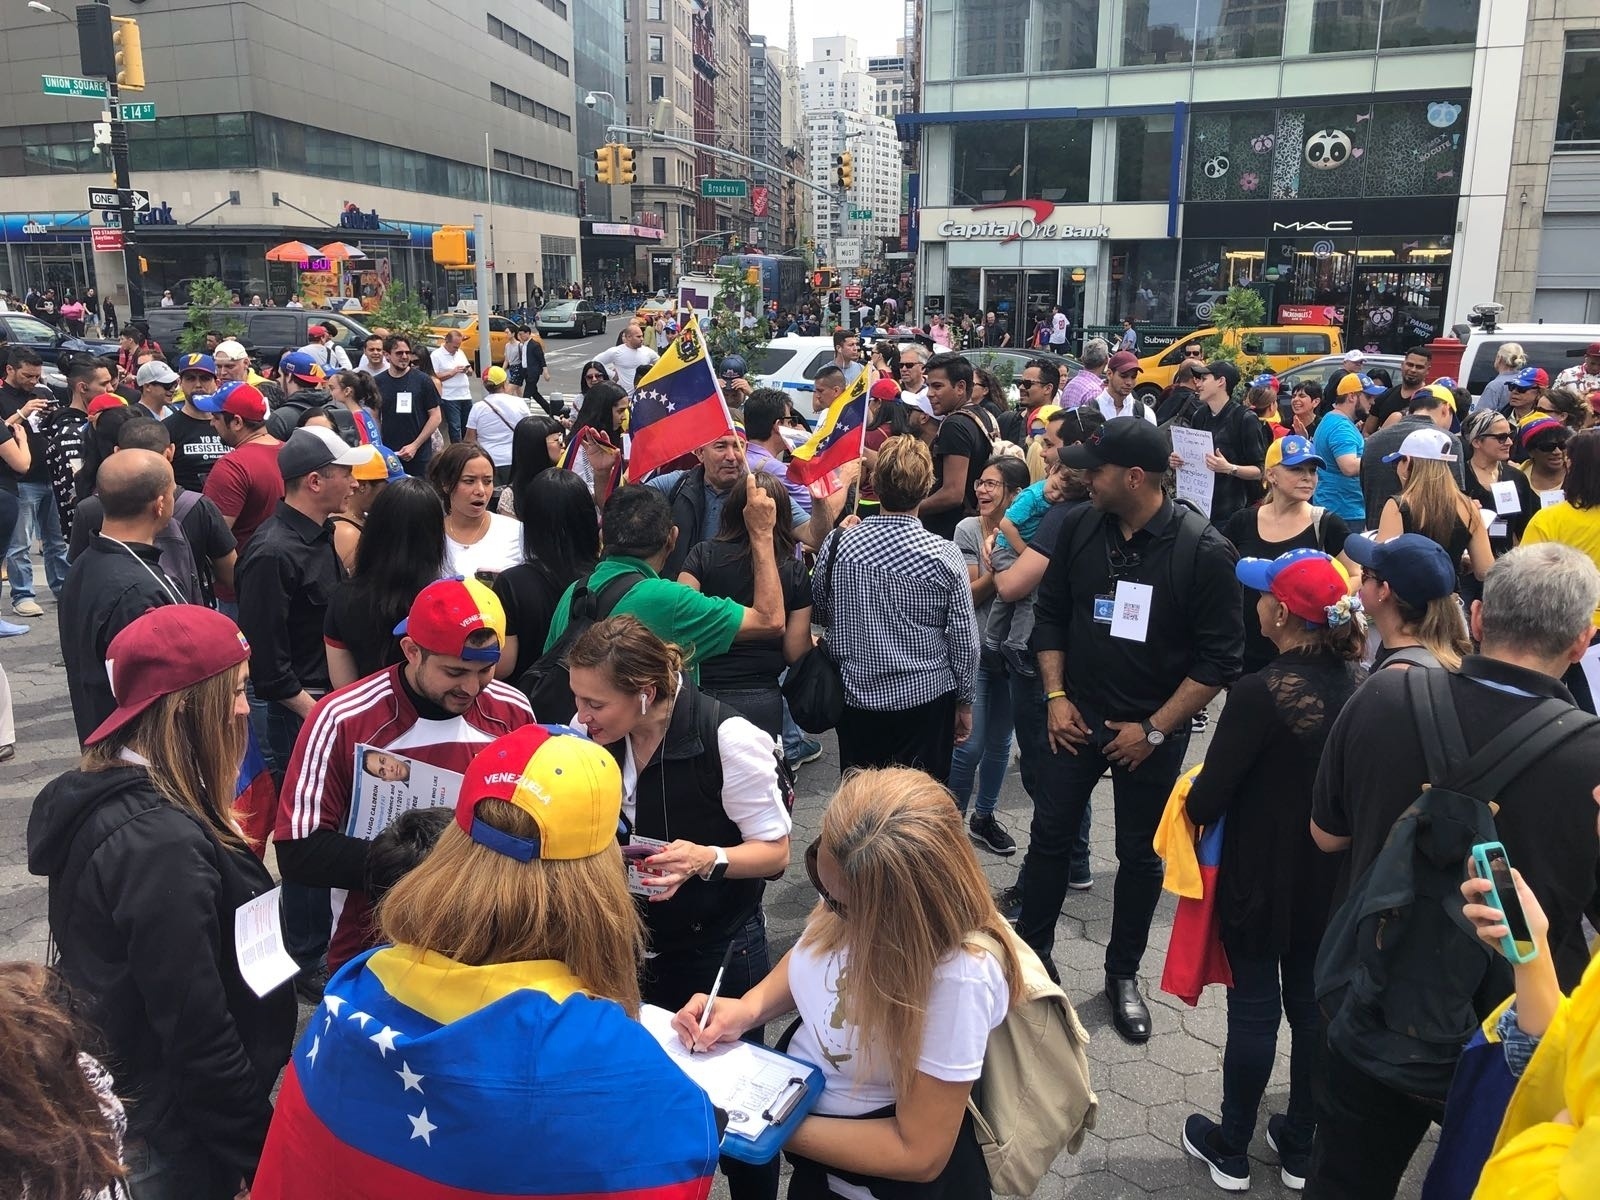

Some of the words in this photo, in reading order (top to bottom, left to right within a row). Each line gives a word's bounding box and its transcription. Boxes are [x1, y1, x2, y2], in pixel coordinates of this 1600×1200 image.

[45, 77, 71, 89] UNION
[73, 80, 105, 92] SQUARE
[122, 106, 129, 119] E
[131, 106, 142, 119] 14
[143, 105, 151, 113] ST
[708, 183, 740, 195] Broadway
[94, 194, 114, 204] ONE
[856, 211, 865, 219] 14
[937, 220, 1017, 239] Capital
[1017, 219, 1057, 239] One
[1061, 224, 1111, 238] Bank
[1308, 310, 1313, 319] 2
[1409, 317, 1434, 331] PANDA
[1413, 327, 1431, 339] RIOT
[1144, 335, 1175, 345] Subway
[200, 435, 211, 444] YO
[212, 435, 222, 444] SO
[185, 444, 235, 453] RESISTEN
[483, 771, 552, 806] VENEZUELA
[370, 784, 379, 816] CALDERON
[387, 796, 395, 822] evidence
[366, 818, 375, 836] LUGO
